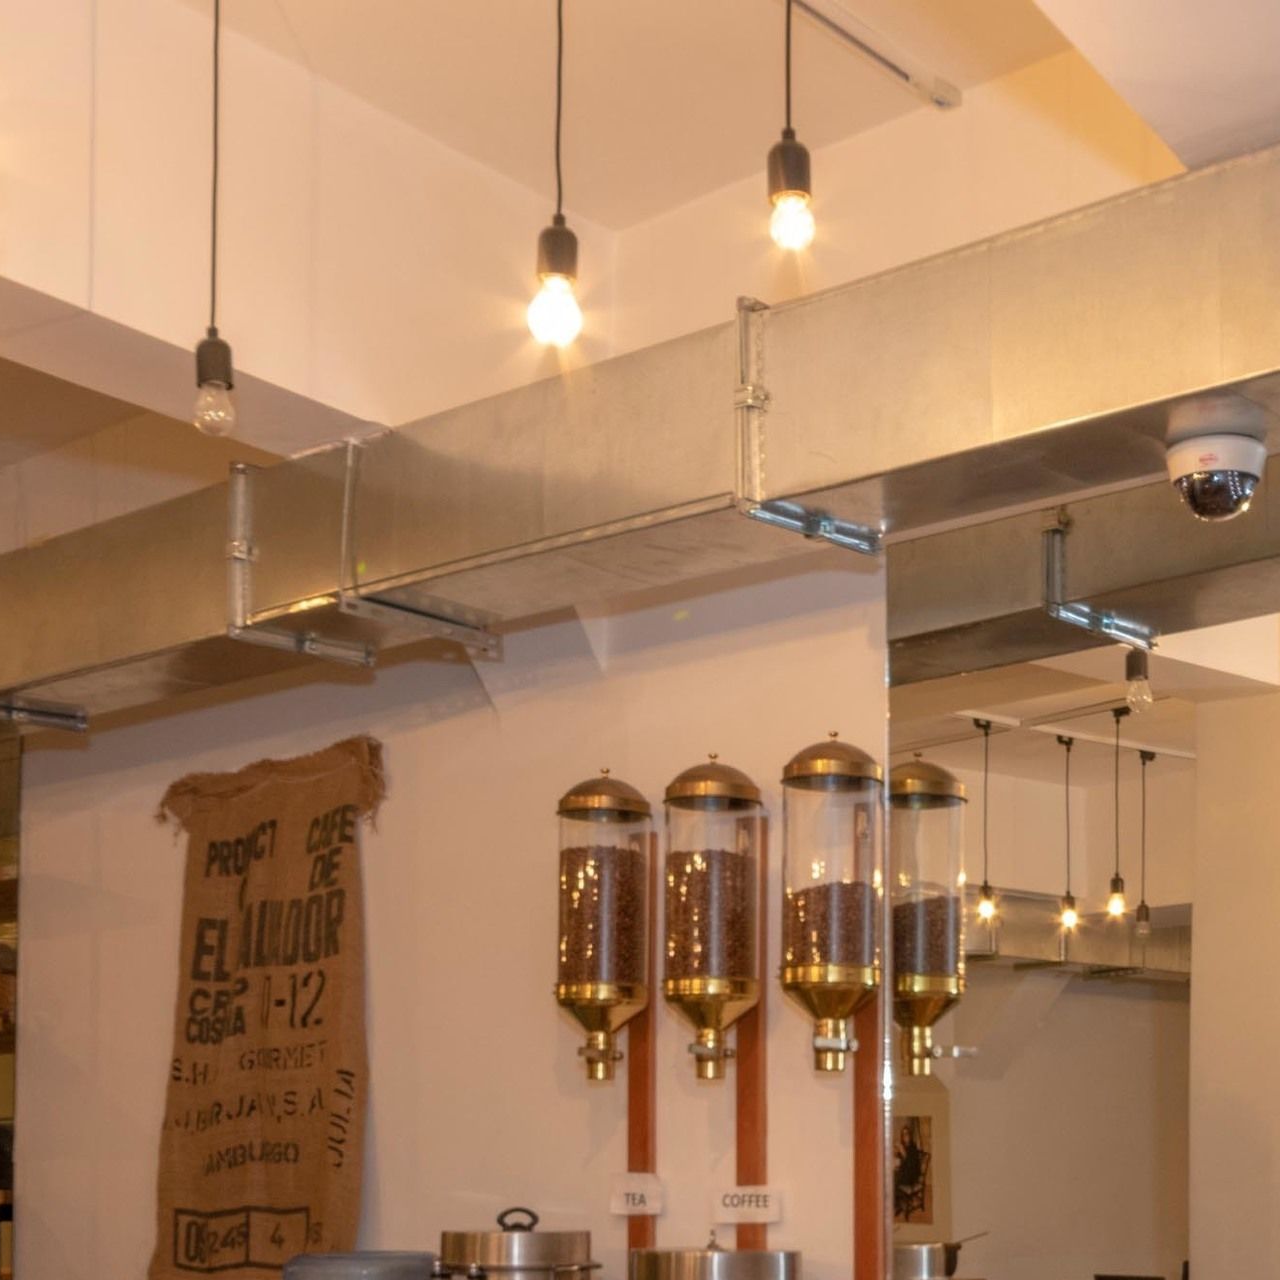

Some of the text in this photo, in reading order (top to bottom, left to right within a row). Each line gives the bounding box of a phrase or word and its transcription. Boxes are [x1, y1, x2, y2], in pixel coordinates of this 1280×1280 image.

[309, 846, 342, 890] DE
[625, 1192, 647, 1208] TEA
[722, 1193, 769, 1209] COFFEE
